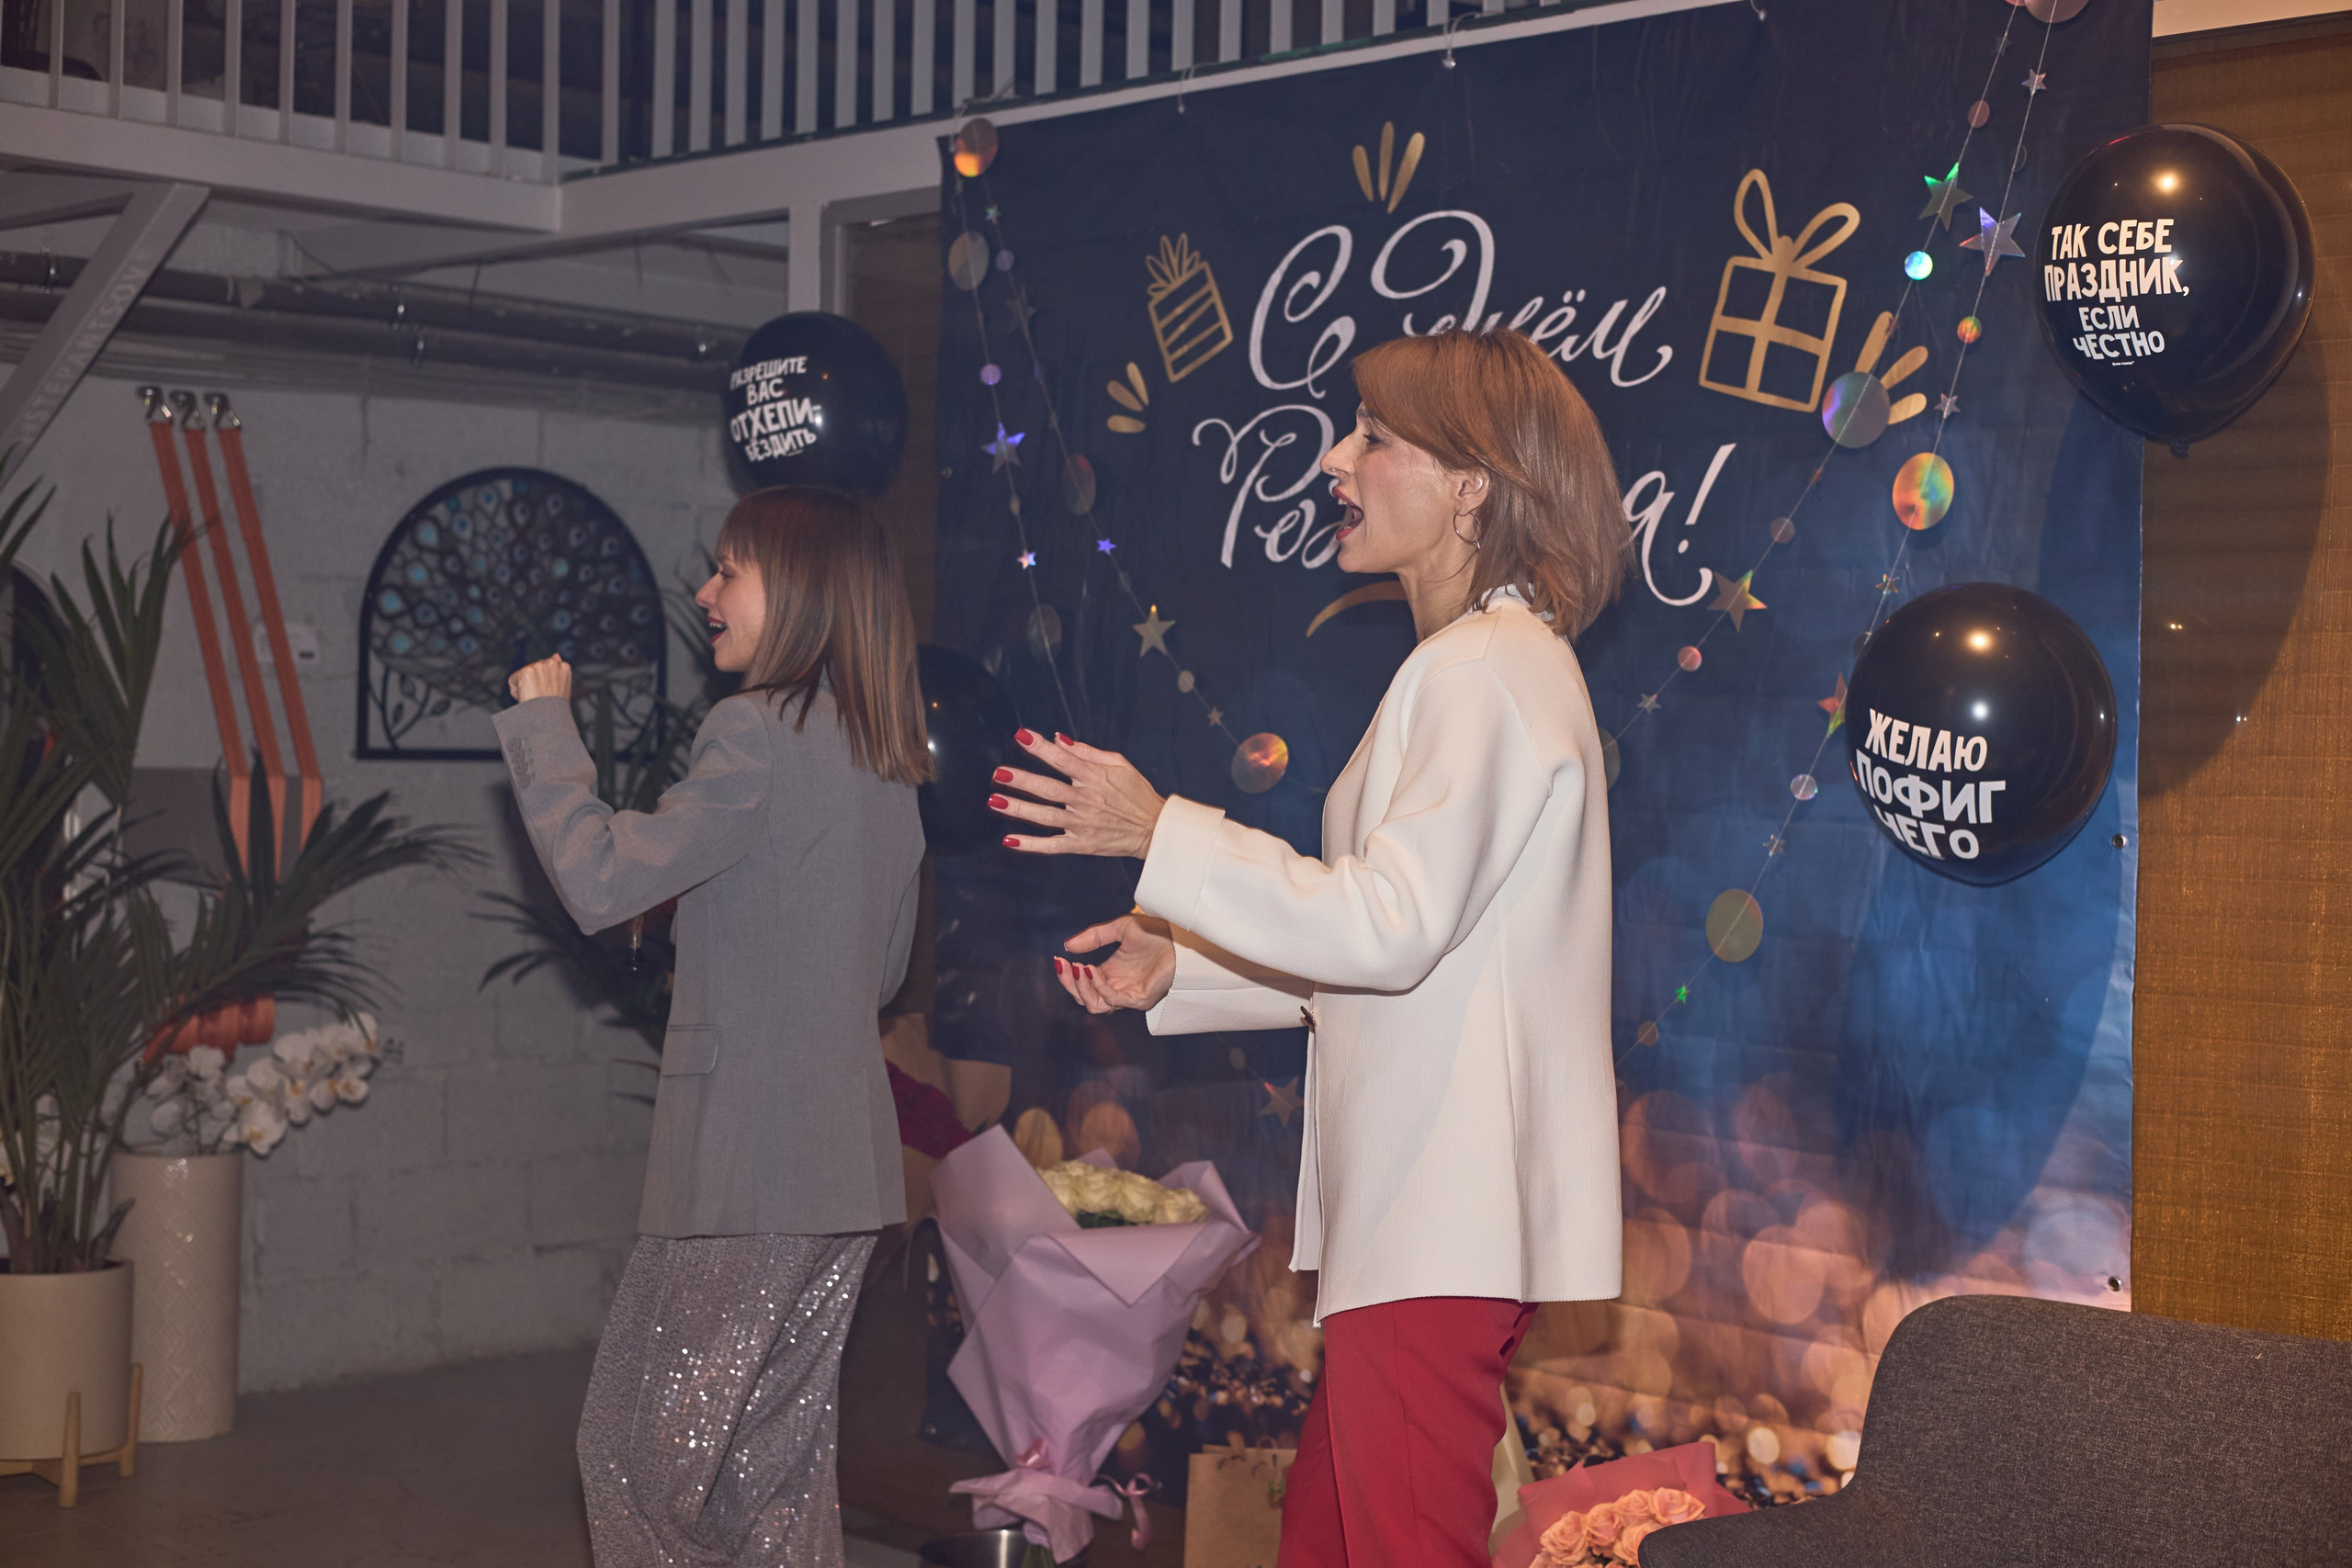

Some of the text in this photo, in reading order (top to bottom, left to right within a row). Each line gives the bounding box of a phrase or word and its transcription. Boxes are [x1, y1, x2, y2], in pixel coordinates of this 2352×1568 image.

[2052, 219, 2175, 260] ТАК СЕБЕ
[2044, 256, 2190, 304] ПРАЗДНИК,
[2078, 305, 2141, 332] ЕСЛИ
[2073, 330, 2165, 360] ЧЕСТНО
[730, 356, 808, 390] РАЗРЕШИТЕ
[746, 378, 785, 406] ВАС
[730, 397, 822, 444] ОТХЕПИ-
[1864, 708, 1987, 773] ЖЕЛАЮ
[1856, 749, 2006, 824] ПОФИГ
[1873, 805, 1980, 860] ЧЕГО
